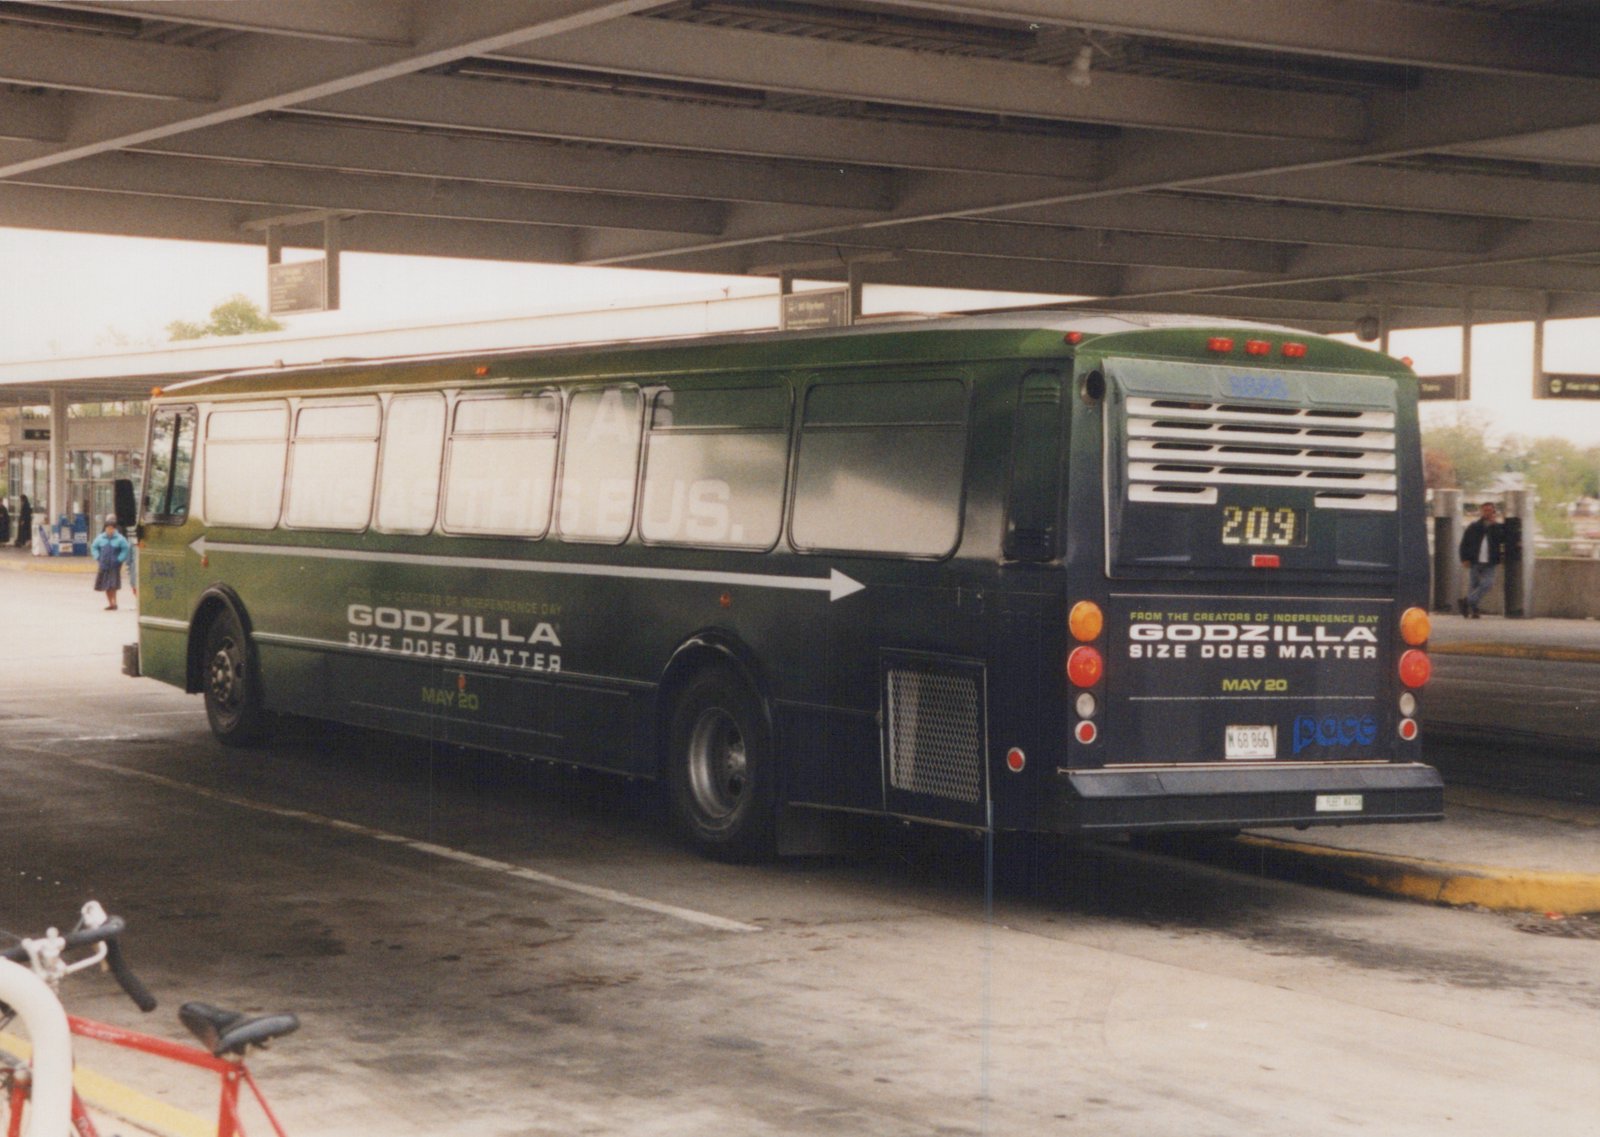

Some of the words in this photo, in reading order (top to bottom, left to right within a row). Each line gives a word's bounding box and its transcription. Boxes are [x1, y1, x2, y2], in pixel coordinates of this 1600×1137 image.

[1222, 505, 1295, 546] 209
[347, 603, 562, 647] GODZILLA
[1130, 612, 1162, 621] FROM
[1168, 613, 1188, 622] THE
[1193, 613, 1251, 622] CREATORS
[1255, 613, 1269, 622] OF
[1273, 614, 1355, 623] INDEPENDENCE
[1358, 615, 1379, 624] DAY
[1129, 623, 1378, 643] GODZILLA
[348, 631, 391, 652] SIZE
[402, 638, 457, 660] DOES
[468, 645, 562, 673] MATTER
[1129, 644, 1187, 658] SIZE
[1201, 644, 1266, 659] DOES
[1279, 645, 1377, 659] MATTER
[1222, 678, 1262, 692] MAY
[1264, 678, 1288, 692] 20
[422, 687, 454, 707] MAY
[458, 691, 480, 711] 20
[1293, 713, 1377, 754] pace
